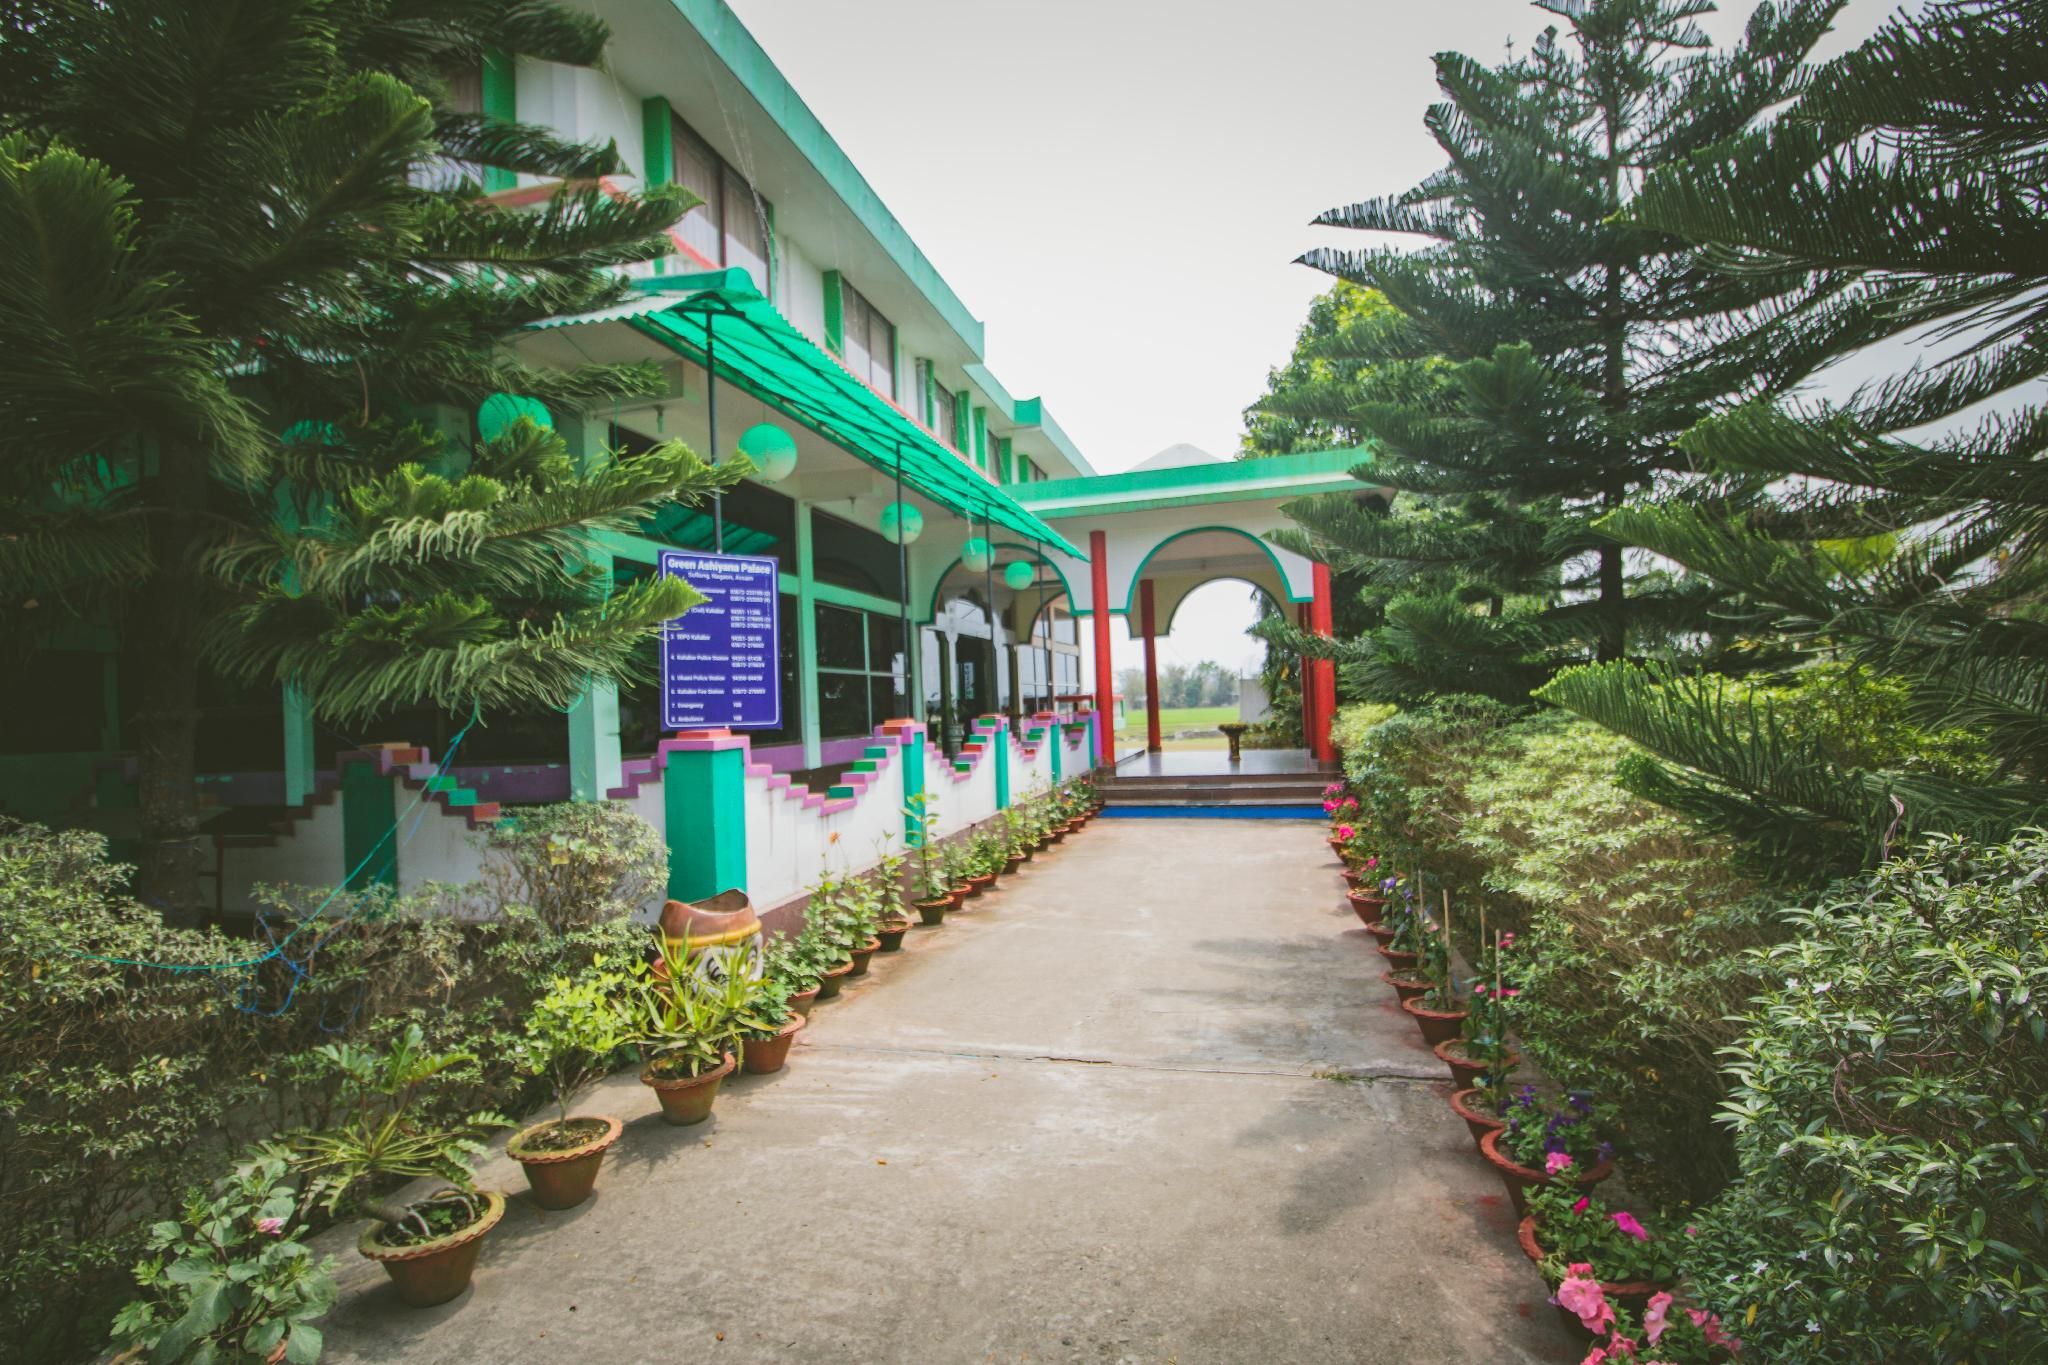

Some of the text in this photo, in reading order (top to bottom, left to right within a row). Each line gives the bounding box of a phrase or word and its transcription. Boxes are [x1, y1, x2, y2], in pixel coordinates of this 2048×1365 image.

[668, 559, 771, 574] Green Ashiyana Palace
[677, 702, 704, 710] Emergency
